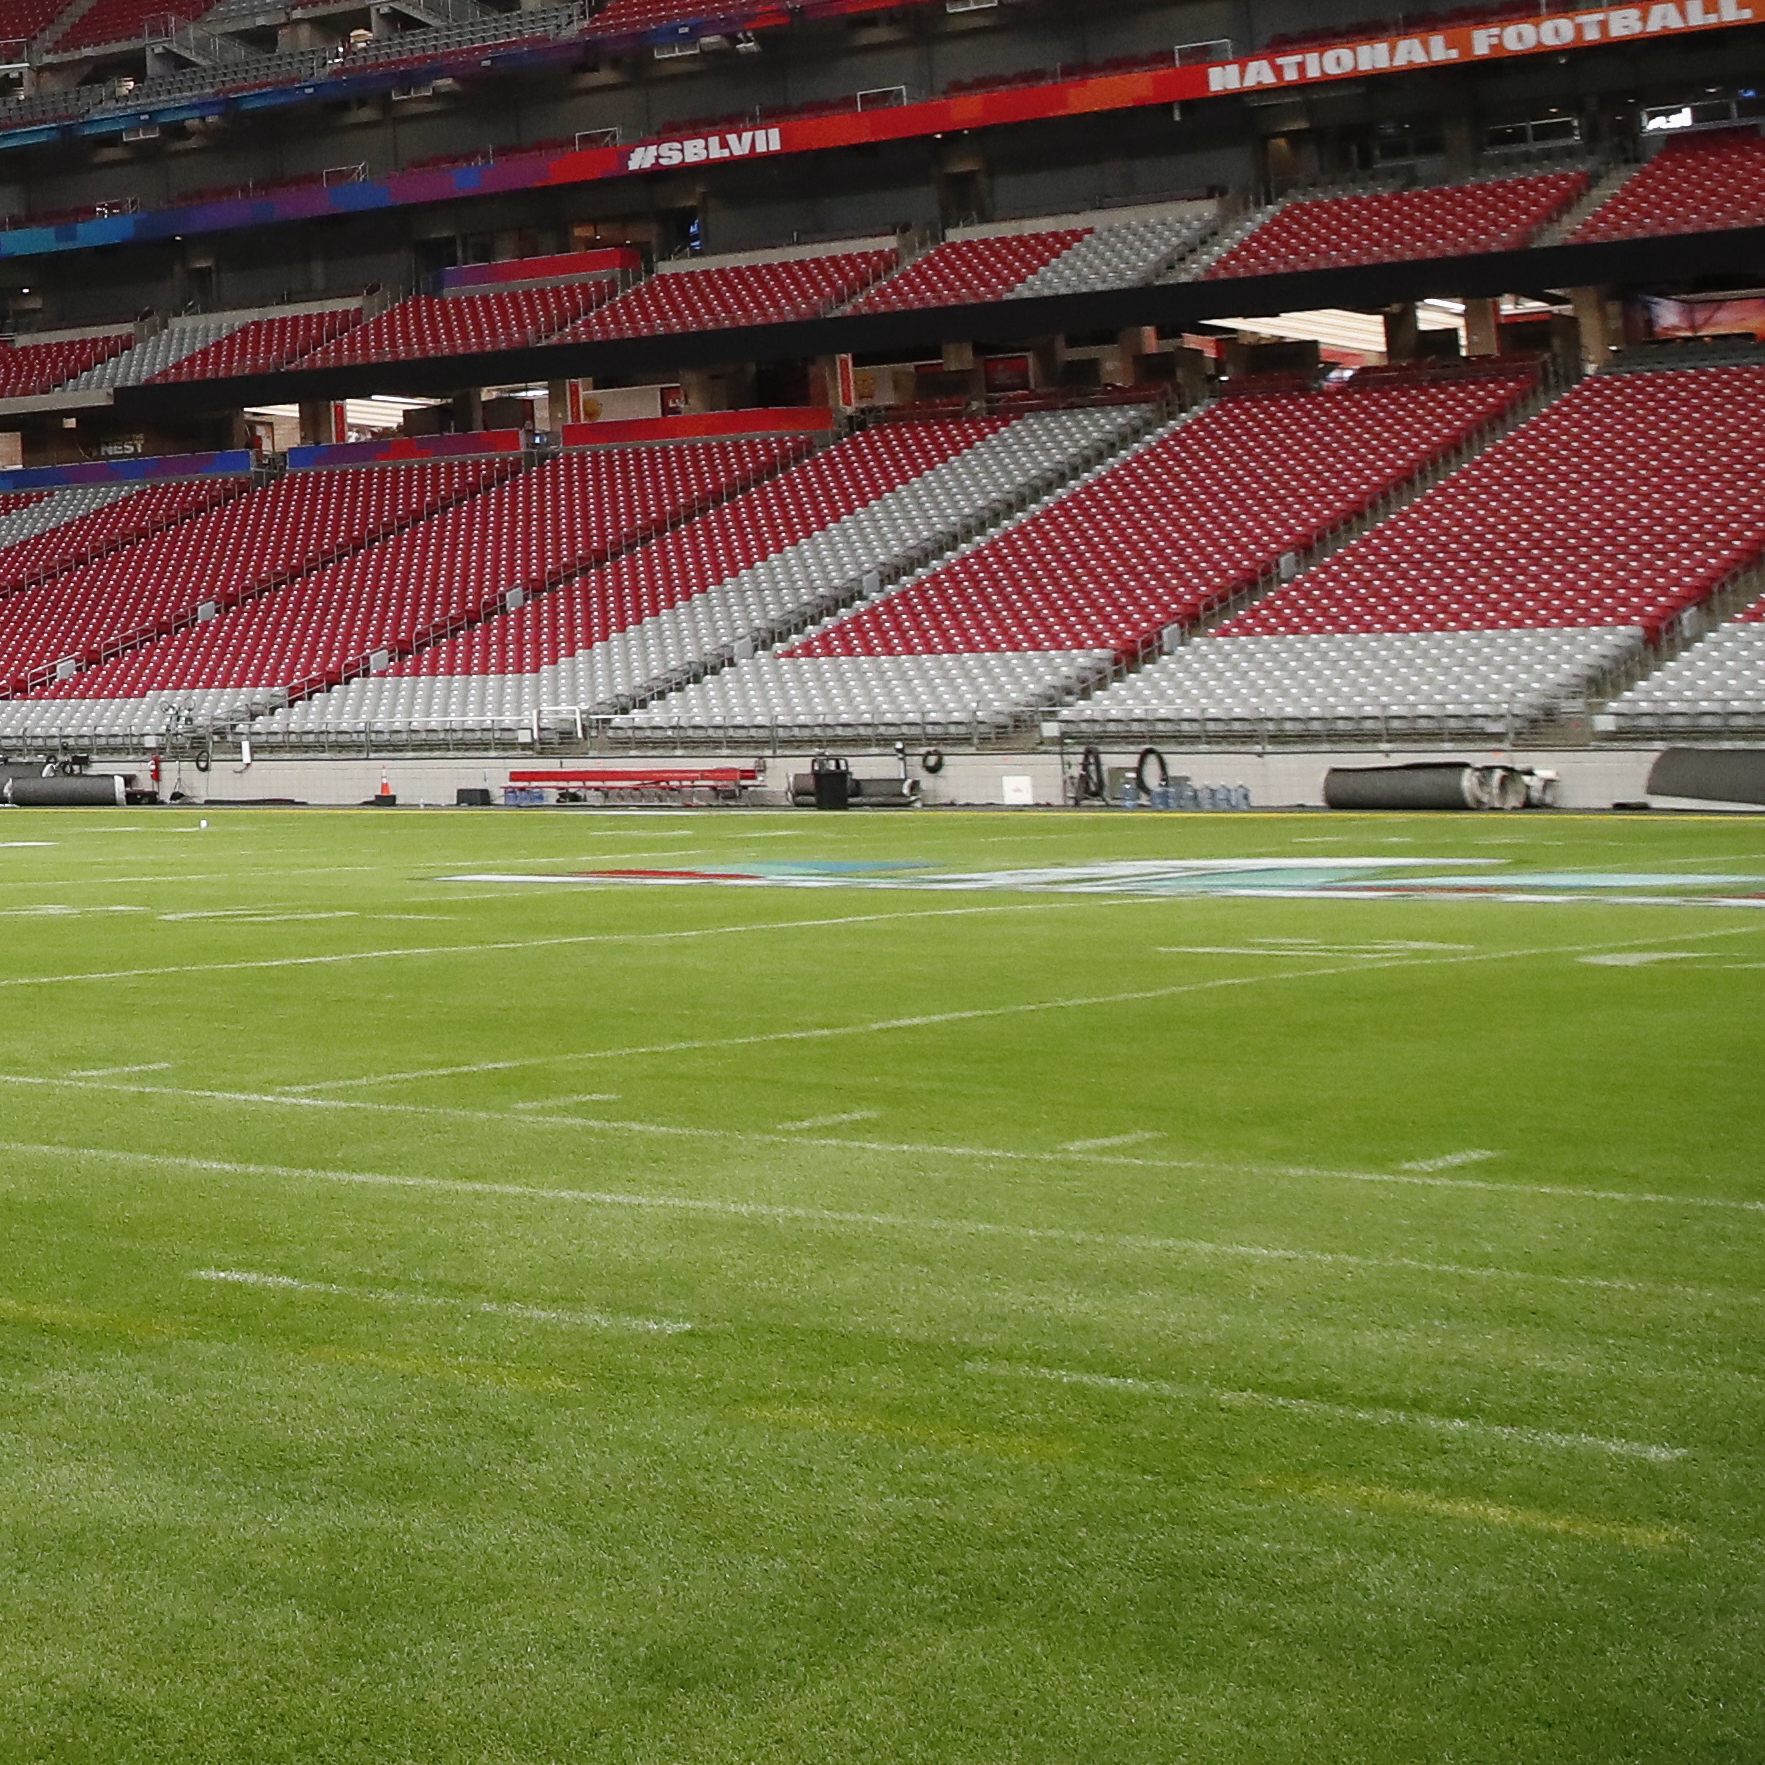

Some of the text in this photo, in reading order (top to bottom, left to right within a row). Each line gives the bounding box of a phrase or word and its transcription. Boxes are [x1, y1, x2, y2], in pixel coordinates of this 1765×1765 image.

[1207, 34, 1460, 94] NATIONAL
[627, 126, 783, 172] #SBLVII
[100, 441, 145, 455] NEST
